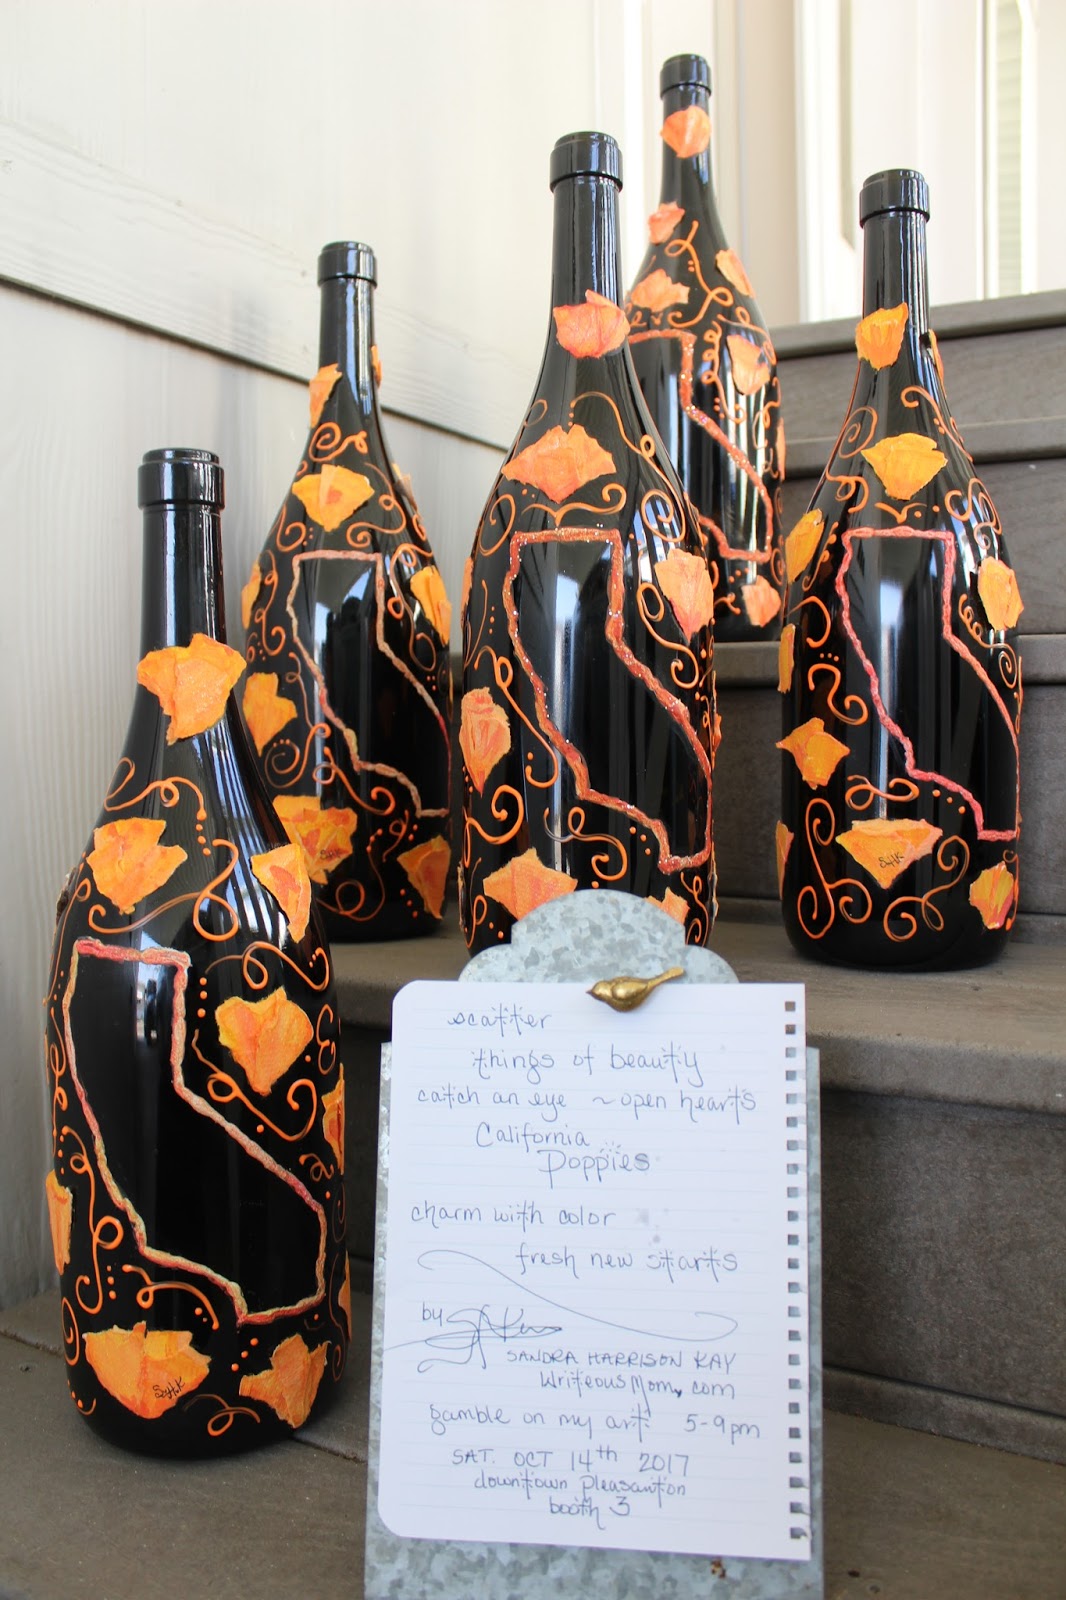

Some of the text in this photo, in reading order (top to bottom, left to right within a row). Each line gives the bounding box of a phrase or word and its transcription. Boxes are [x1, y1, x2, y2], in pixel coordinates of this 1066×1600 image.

[447, 1003, 552, 1037] scatter
[471, 1041, 704, 1088] things of beauty
[417, 1085, 480, 1110] catch
[493, 1092, 519, 1106] an
[528, 1092, 567, 1122] eye
[680, 1085, 757, 1125] hearts
[476, 1122, 590, 1153] California
[537, 1148, 650, 1189] Poppies
[411, 1200, 617, 1233] charm with color
[515, 1243, 738, 1283] fresh new starts
[421, 1302, 443, 1327] by
[506, 1349, 737, 1374] SANDRA HARRISON KAY
[430, 1403, 511, 1436] gamble
[523, 1412, 546, 1426] on
[559, 1415, 592, 1439] my
[606, 1403, 651, 1443] art
[513, 1451, 553, 1468] OCT
[571, 1445, 619, 1472] 14th
[638, 1453, 690, 1477] 2017
[474, 1470, 568, 1500] downtown
[549, 1495, 631, 1530] booth 3
